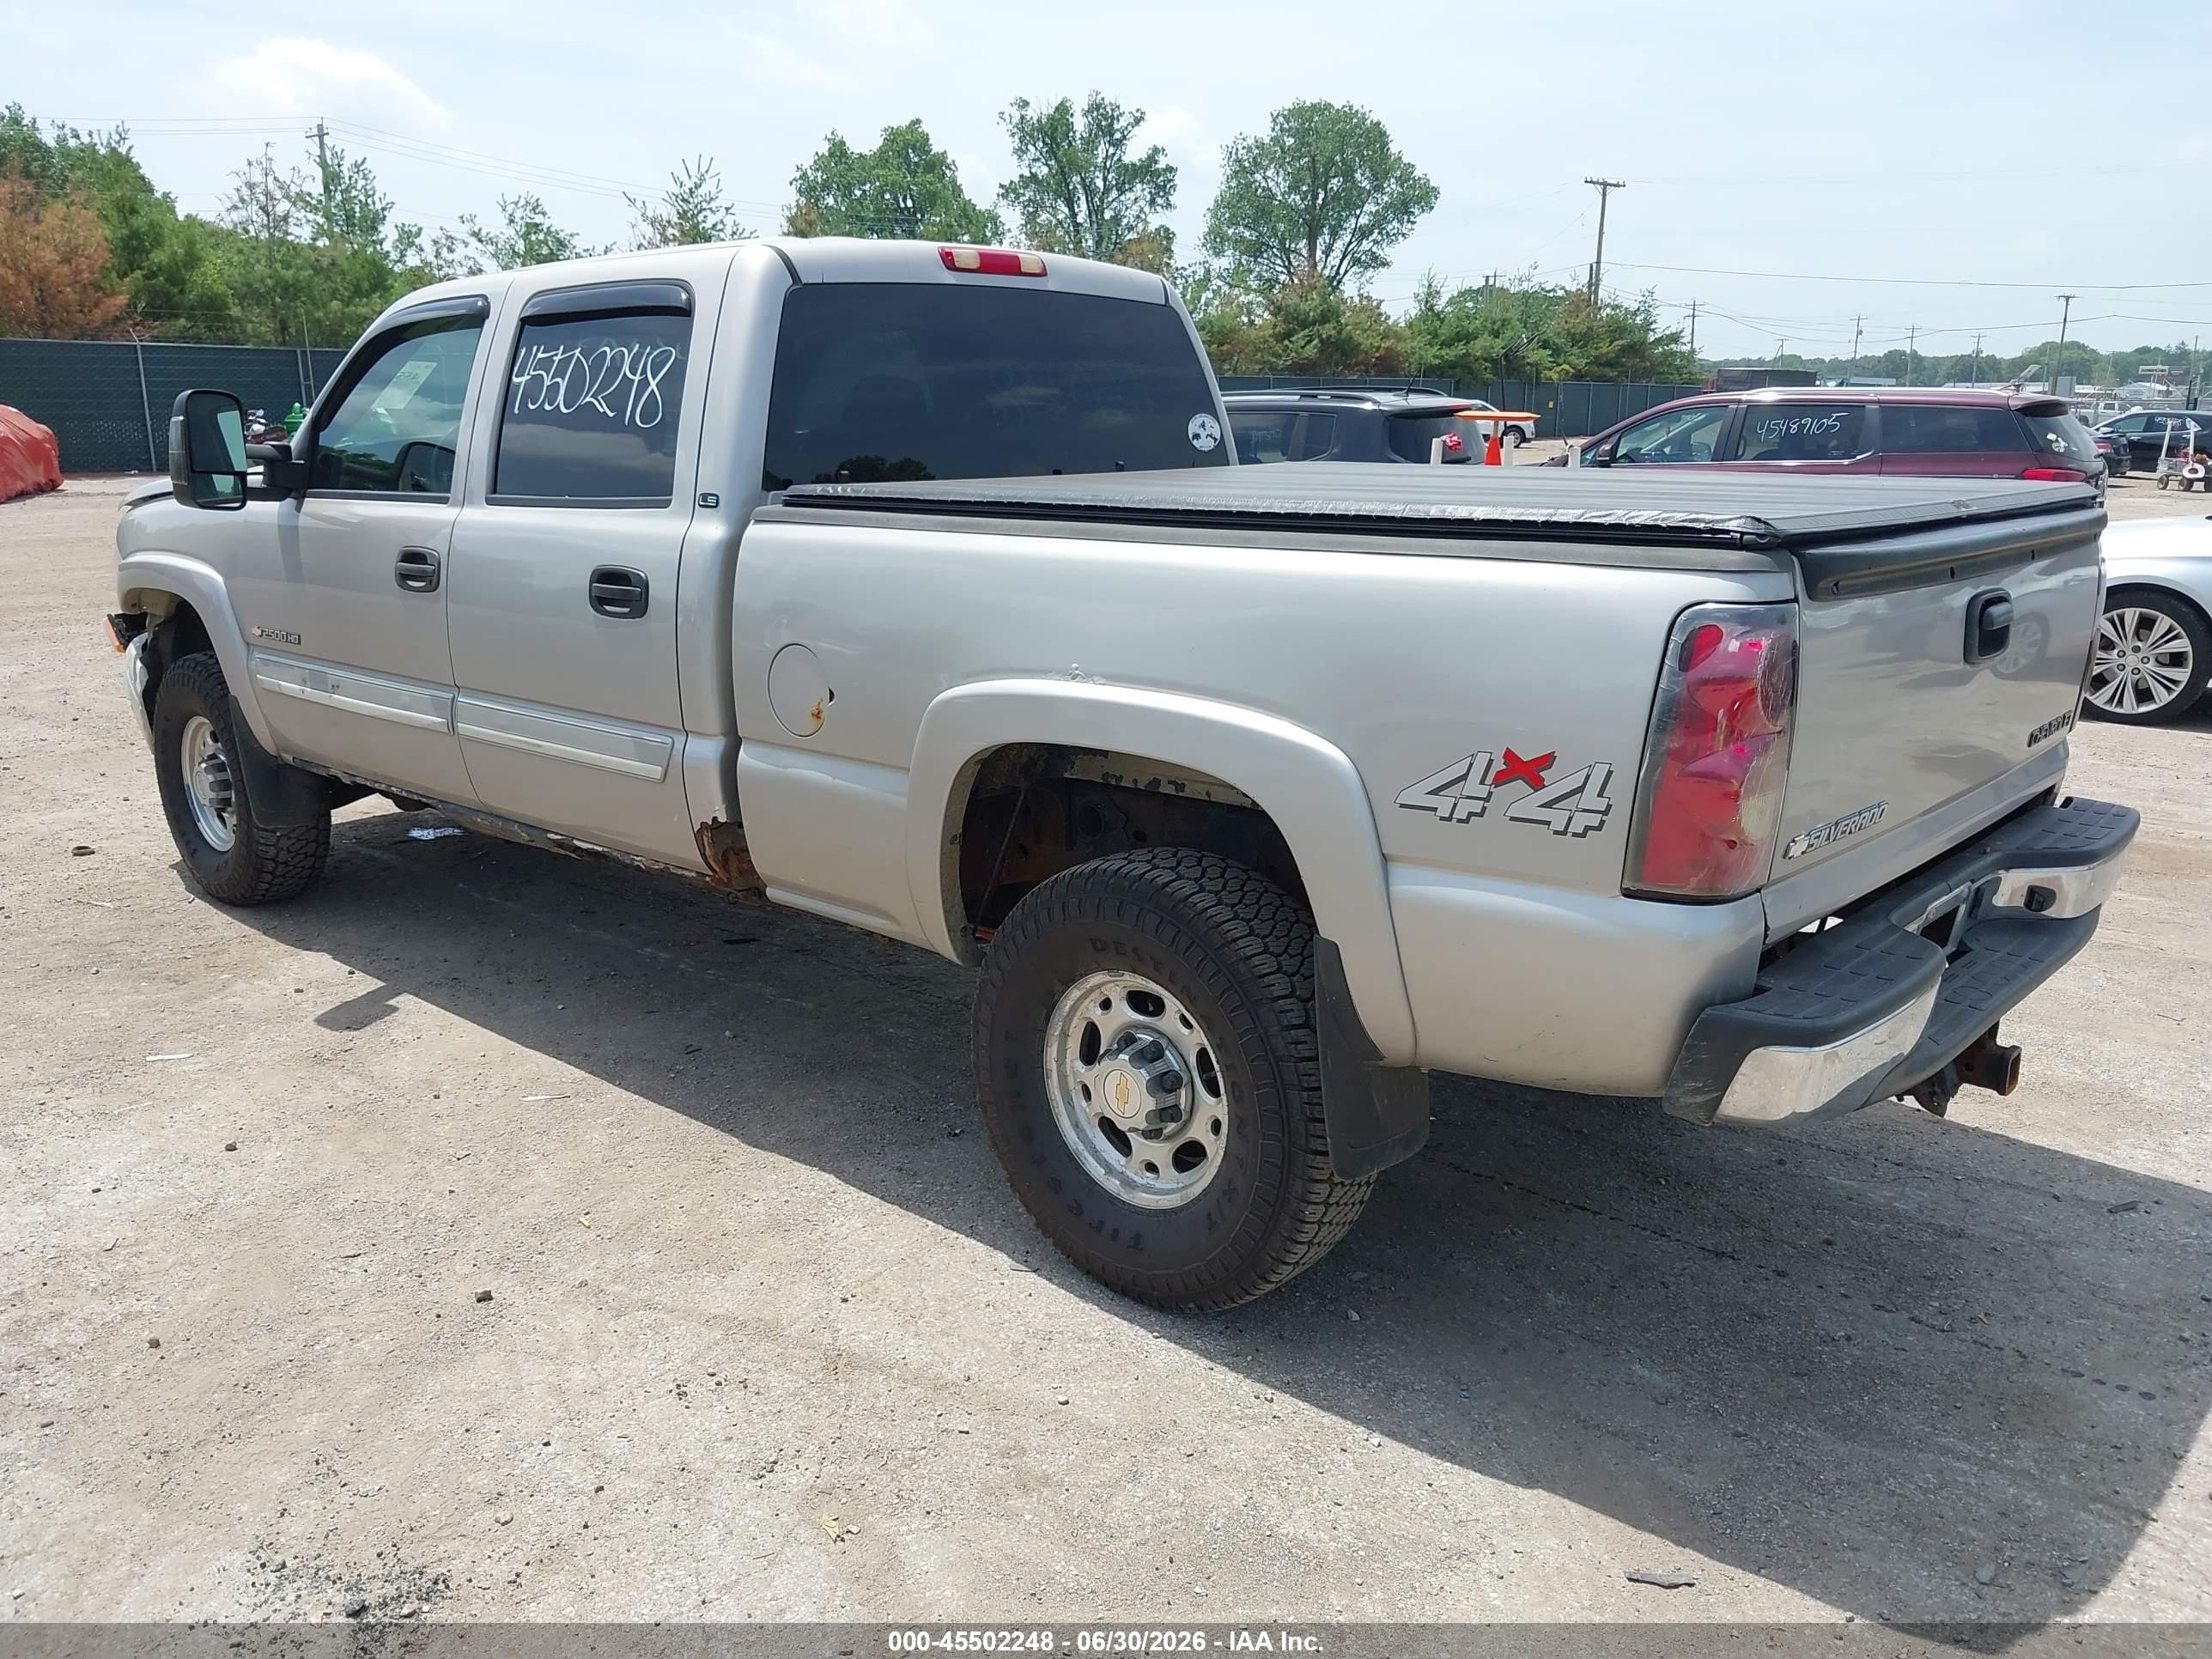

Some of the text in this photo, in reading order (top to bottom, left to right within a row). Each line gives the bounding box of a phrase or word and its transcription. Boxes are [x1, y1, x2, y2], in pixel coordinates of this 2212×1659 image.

[512, 343, 676, 428] 45502248
[1756, 412, 1850, 442] 45489105
[699, 495, 718, 507] LS
[1806, 800, 1888, 853] SILVERADO
